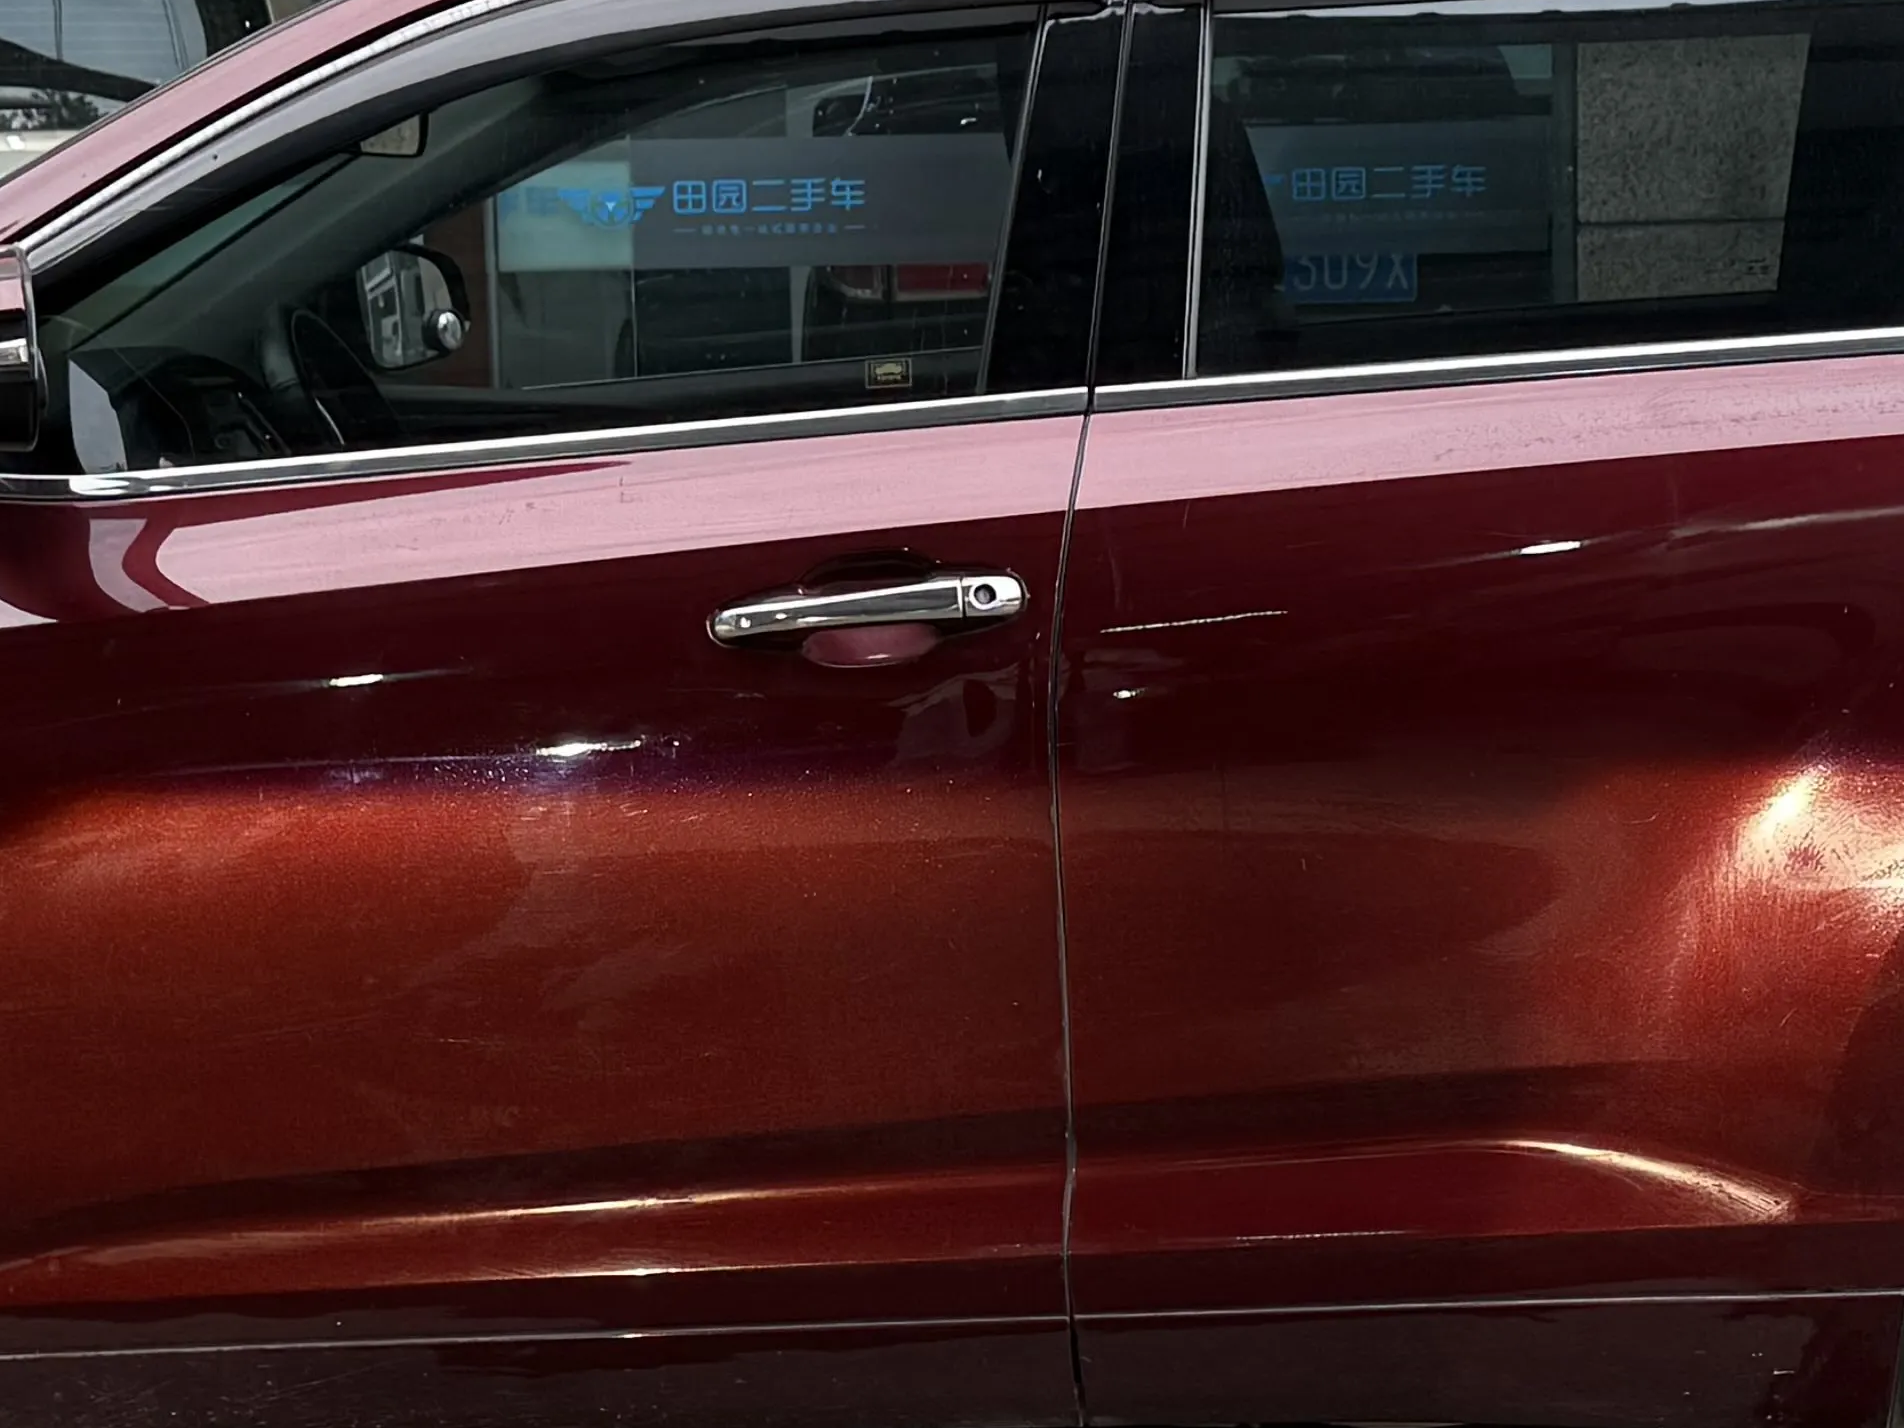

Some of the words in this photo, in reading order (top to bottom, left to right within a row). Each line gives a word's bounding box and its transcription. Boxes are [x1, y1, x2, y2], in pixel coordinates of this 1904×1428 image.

[672, 177, 866, 214] 田园二手车
[1292, 164, 1487, 201] 田园二手车
